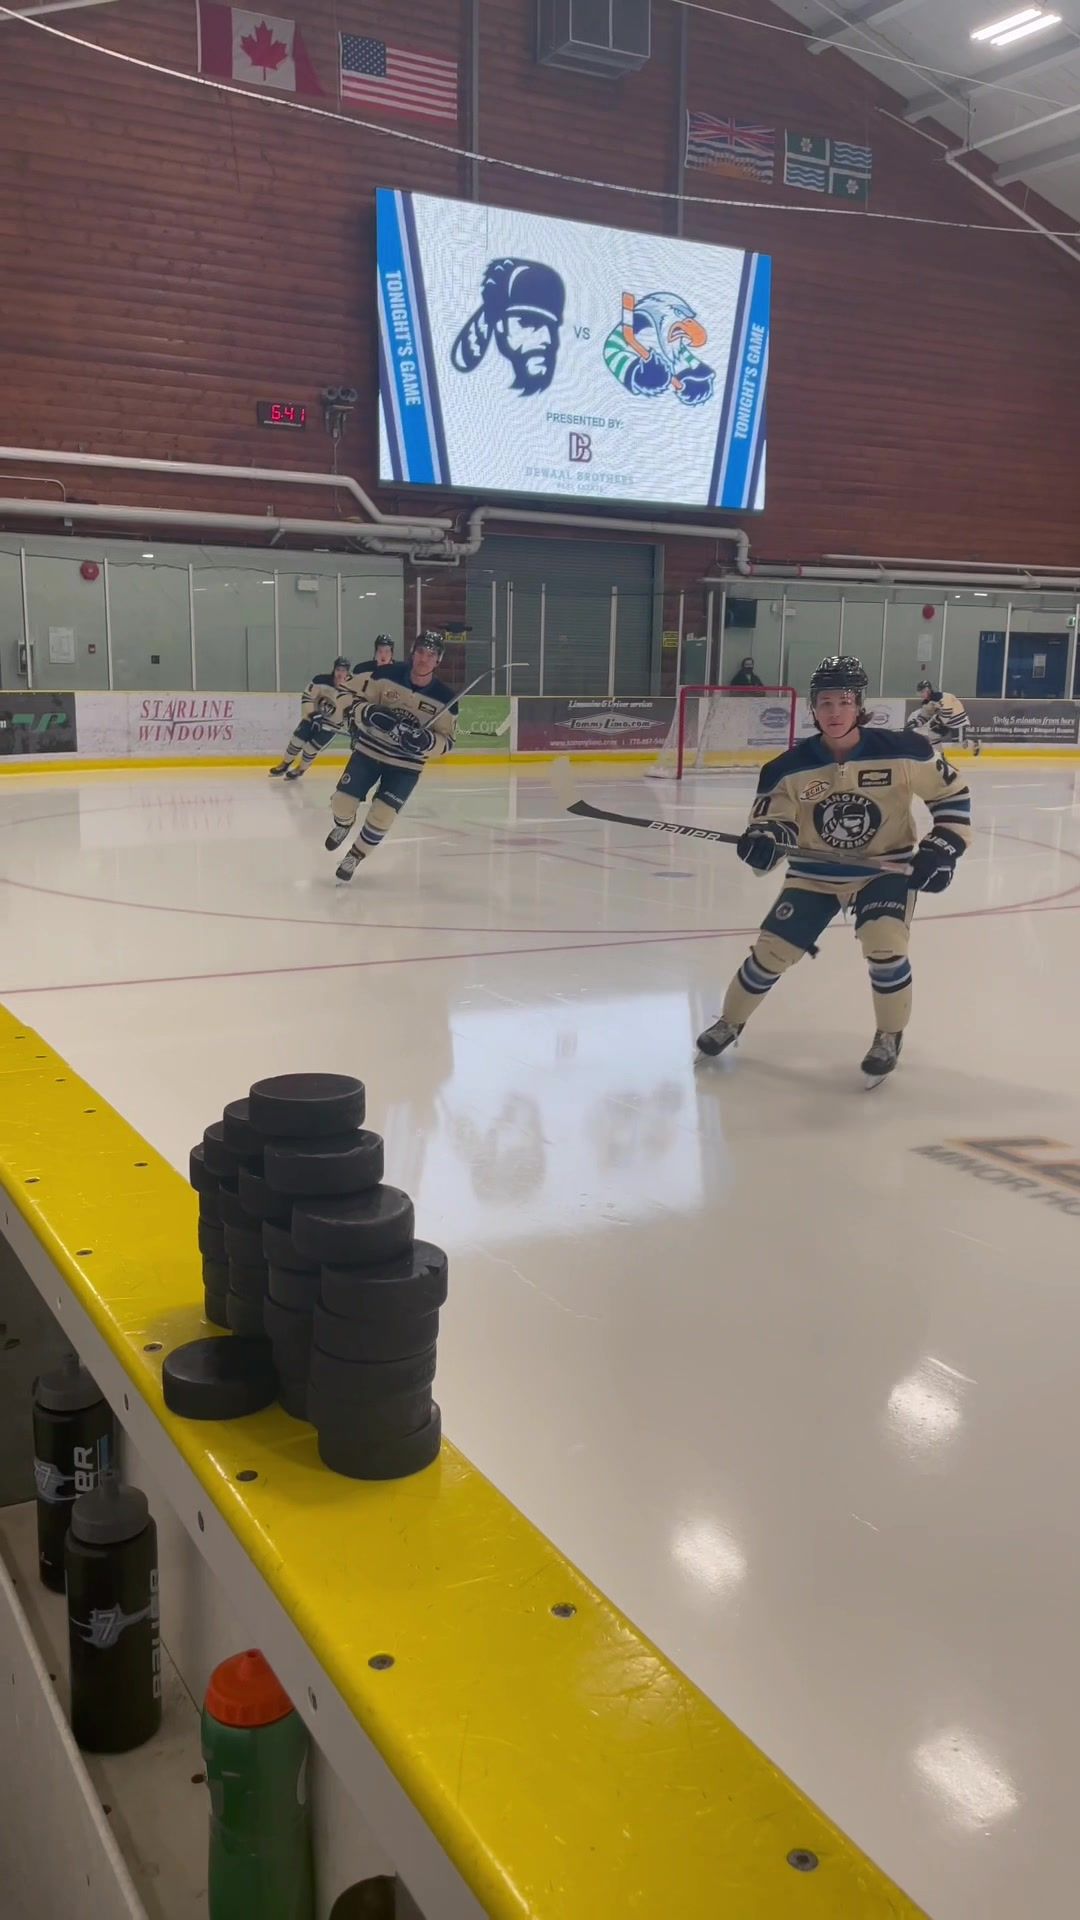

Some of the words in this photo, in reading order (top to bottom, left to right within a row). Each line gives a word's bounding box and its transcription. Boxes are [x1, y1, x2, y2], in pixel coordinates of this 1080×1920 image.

[385, 270, 413, 356] TONIGHT'S
[400, 360, 421, 406] GAME
[573, 326, 591, 340] VS
[734, 366, 758, 439] TONIGHT'S
[746, 323, 765, 364] GAME
[546, 412, 606, 427] PRESENTED
[140, 699, 234, 719] STARLINE
[139, 724, 233, 742] WINDOWS
[819, 793, 872, 809] LANGLEY
[648, 821, 721, 841] BAUER
[820, 827, 877, 849] RIVERMEN
